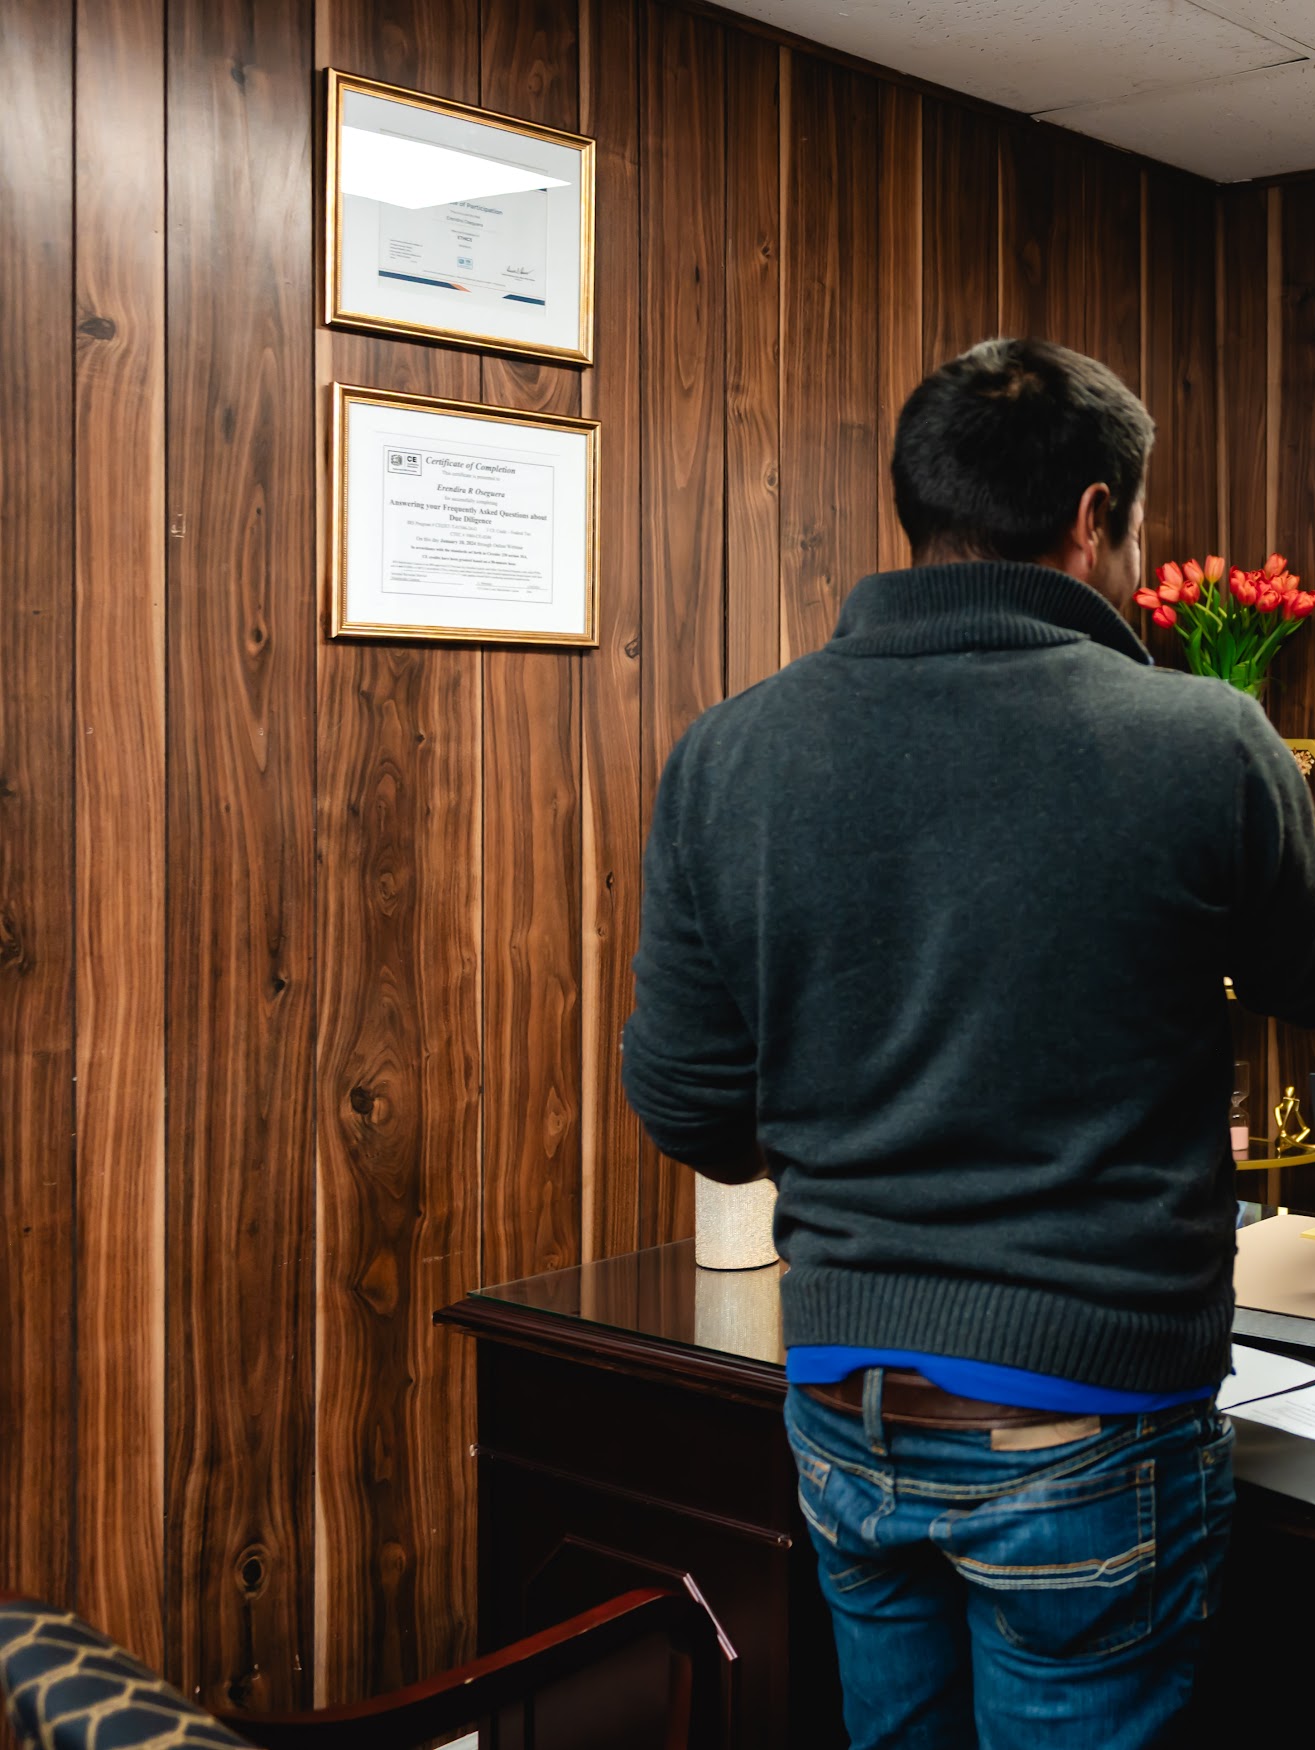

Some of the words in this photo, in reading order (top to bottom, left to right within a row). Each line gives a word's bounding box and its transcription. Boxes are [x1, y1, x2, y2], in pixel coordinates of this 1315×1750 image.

[406, 455, 418, 463] CE
[425, 456, 465, 469] Certificate
[465, 461, 475, 471] of
[475, 463, 516, 475] Completion
[436, 483, 467, 494] Erendira
[475, 488, 506, 498] Oseguera
[389, 499, 425, 510] Answering
[425, 503, 441, 512] your
[443, 504, 478, 515] Frequently
[479, 508, 499, 516] Asked
[499, 510, 530, 519] Questions
[530, 513, 548, 521] about
[449, 514, 462, 522] Due
[463, 515, 492, 525] Diligence
